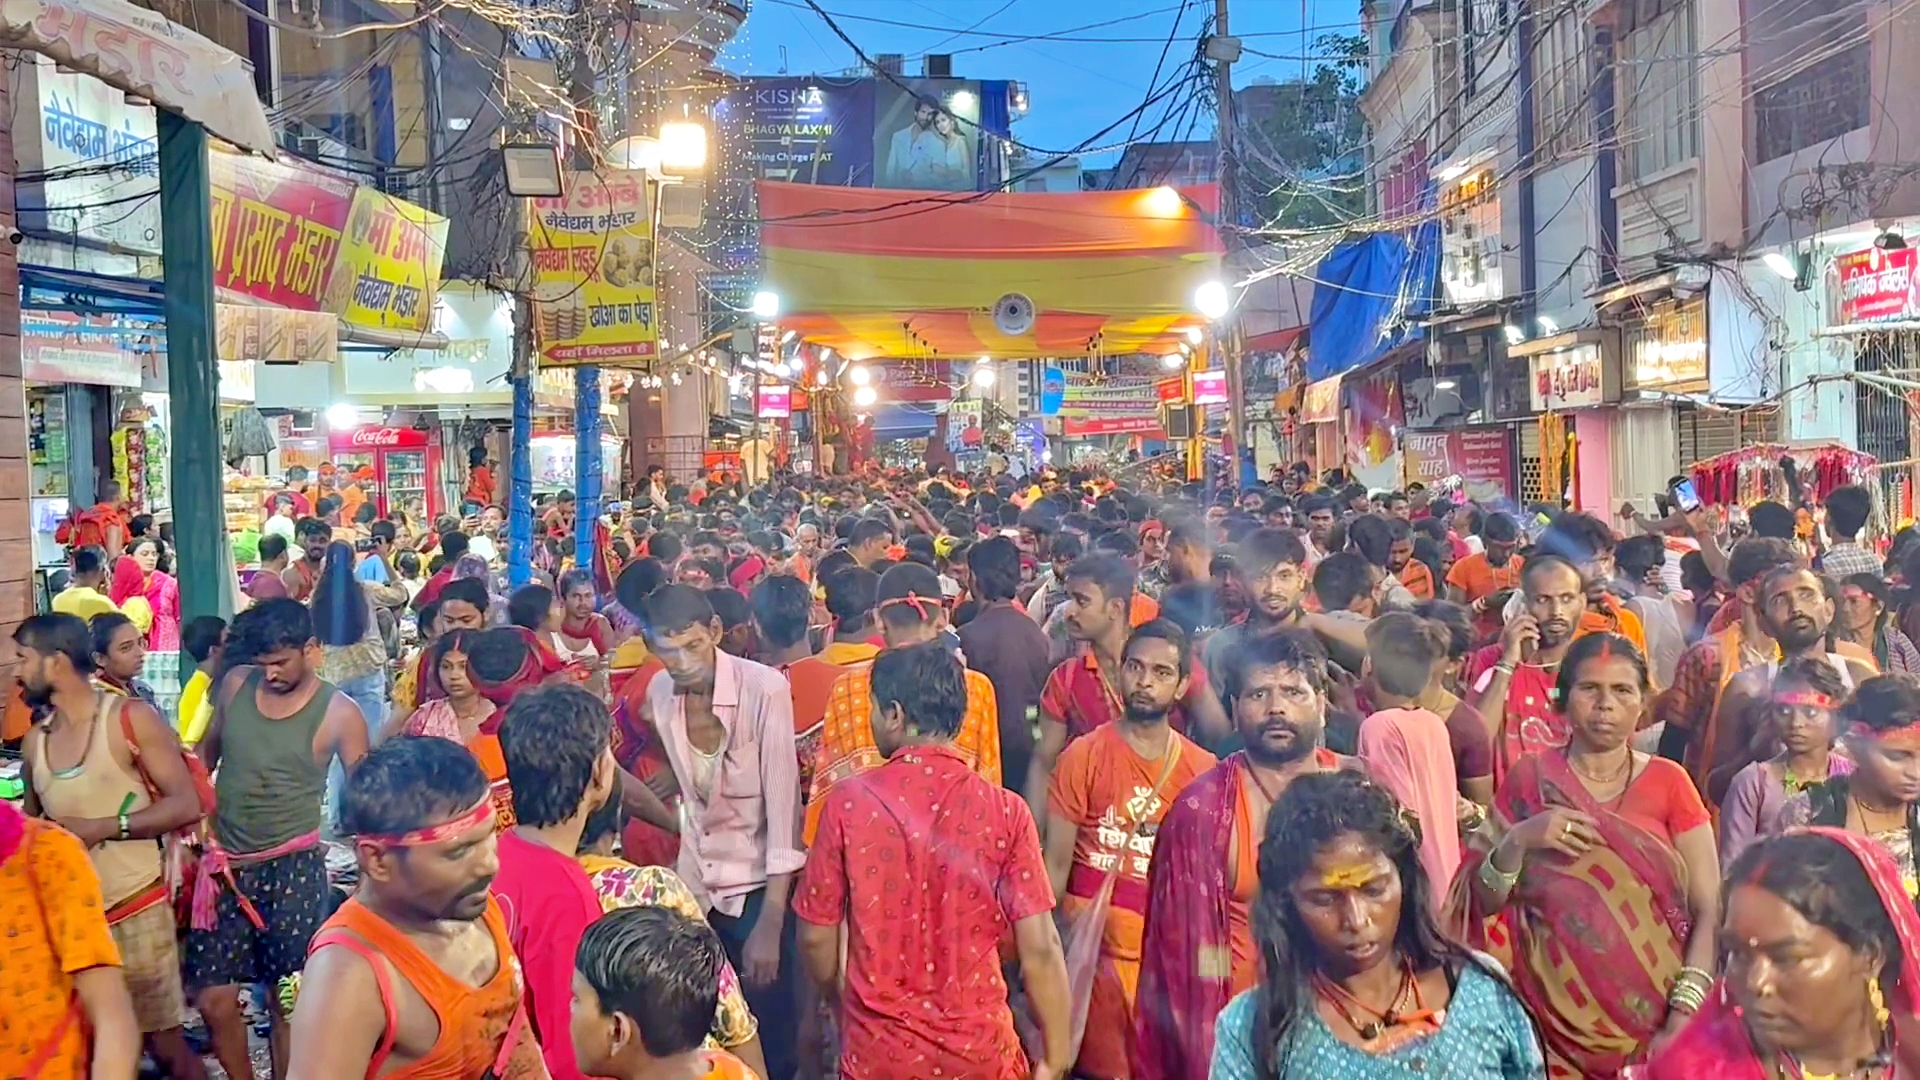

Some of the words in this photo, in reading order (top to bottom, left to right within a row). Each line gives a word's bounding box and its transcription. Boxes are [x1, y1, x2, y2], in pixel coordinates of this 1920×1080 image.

[743, 124, 791, 135] BHAGYA
[742, 152, 775, 162] Making
[777, 152, 808, 163] Chrge
[810, 153, 833, 161] FAT
[617, 303, 632, 324] का
